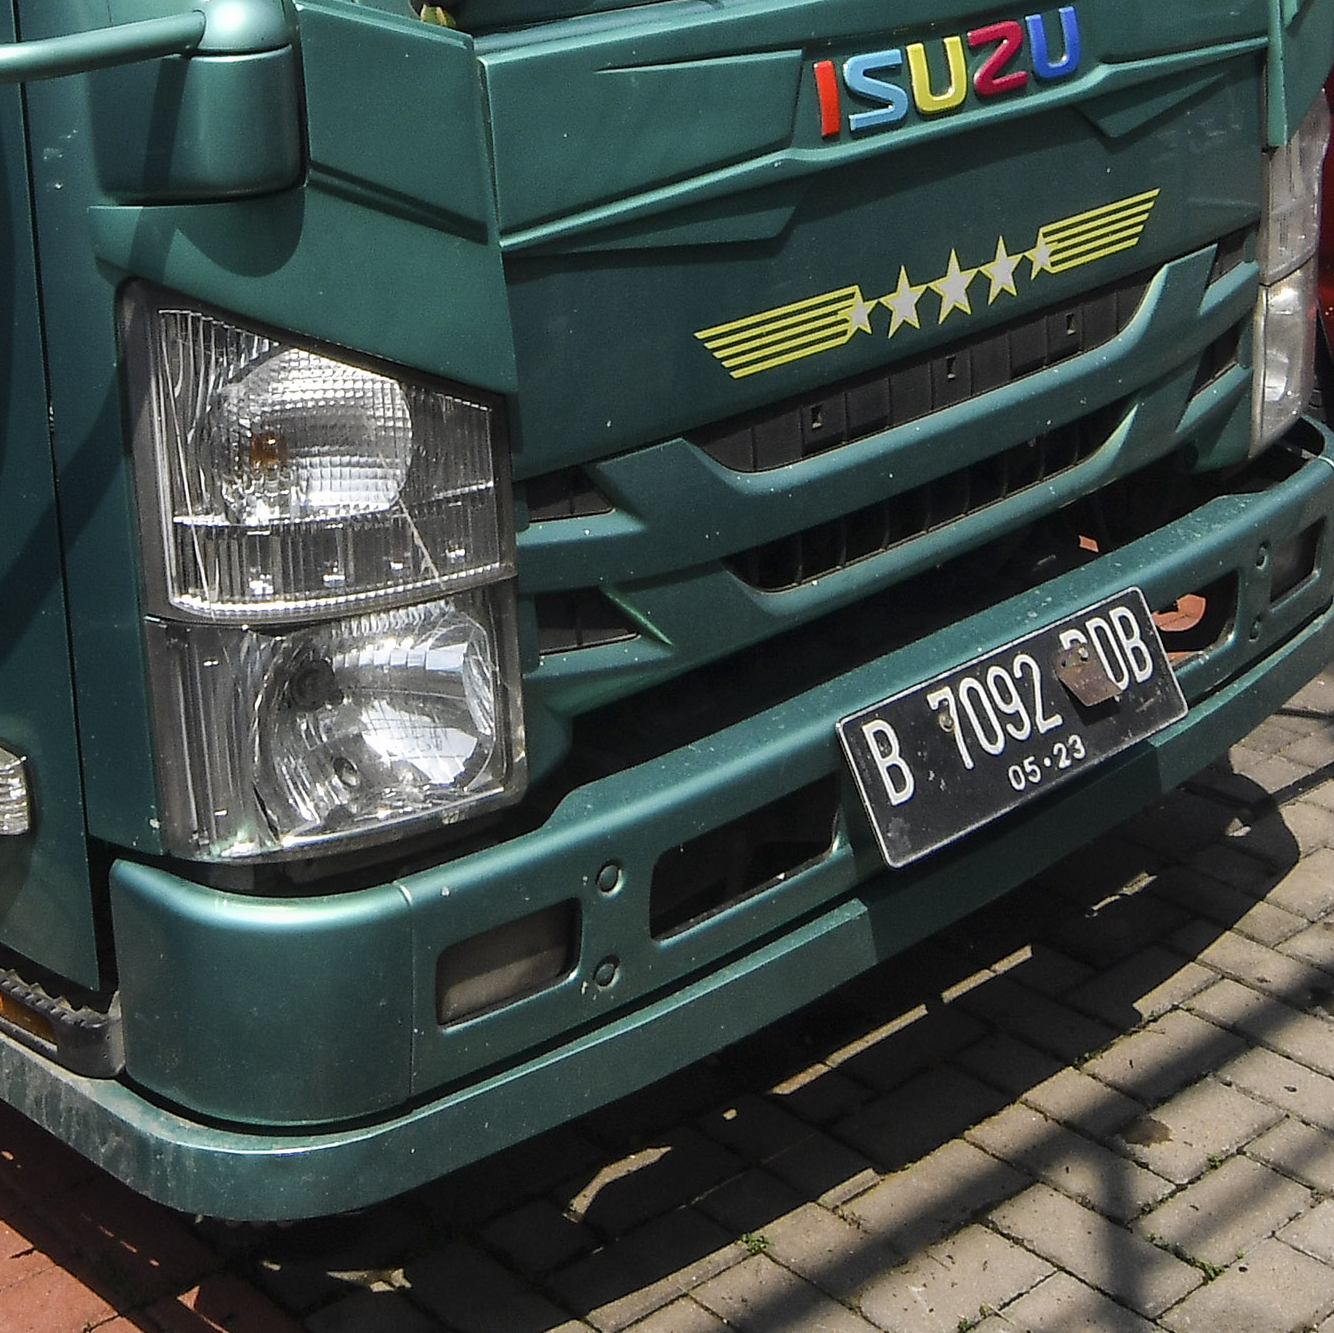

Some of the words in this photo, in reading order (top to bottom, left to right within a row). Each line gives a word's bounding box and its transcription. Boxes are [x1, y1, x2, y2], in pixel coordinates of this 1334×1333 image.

[813, 6, 1083, 138] ISUZU
[861, 719, 915, 806] B
[926, 654, 1063, 771] 7092
